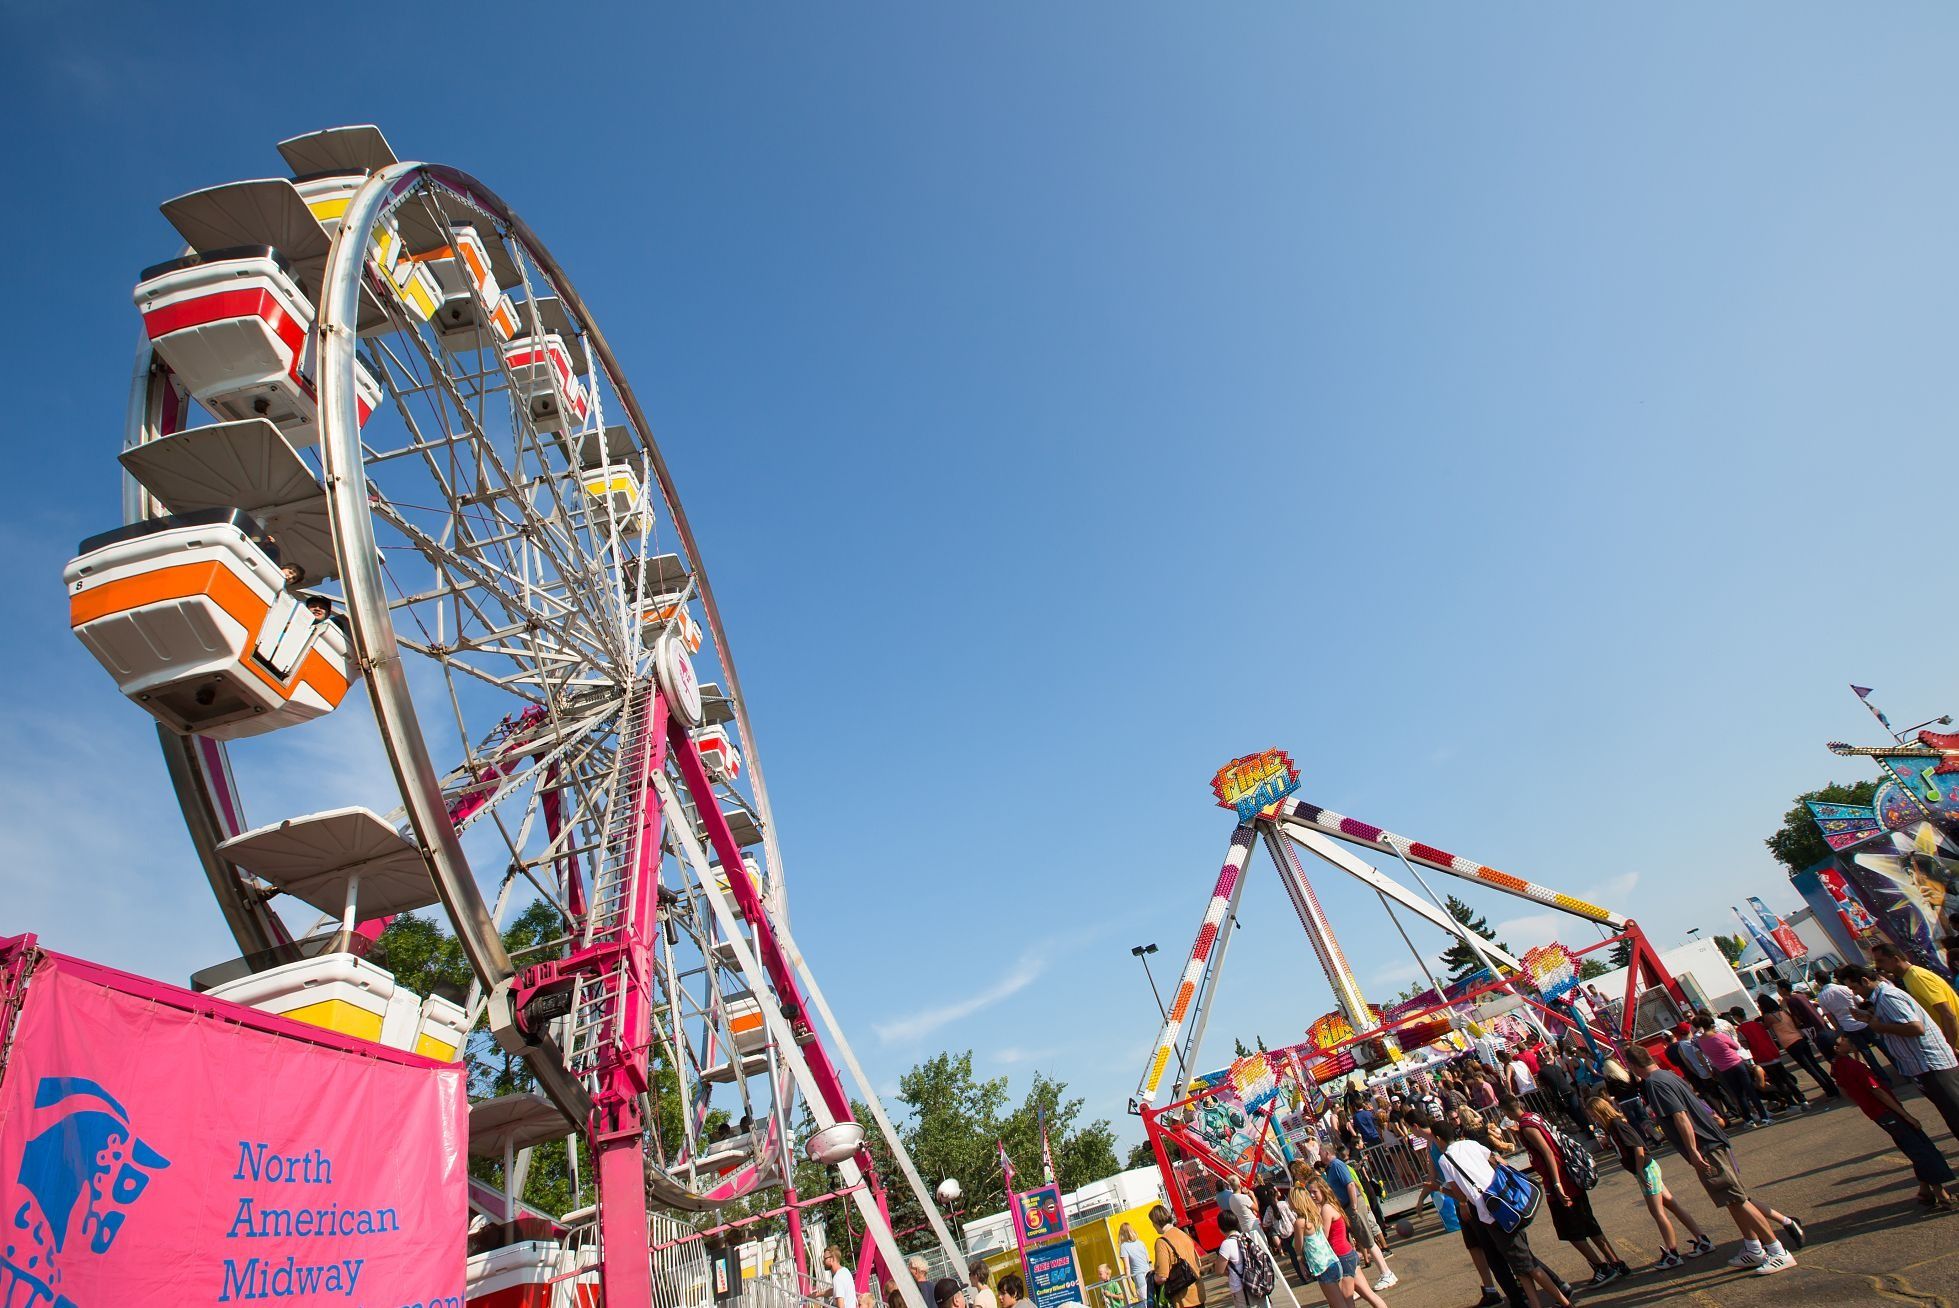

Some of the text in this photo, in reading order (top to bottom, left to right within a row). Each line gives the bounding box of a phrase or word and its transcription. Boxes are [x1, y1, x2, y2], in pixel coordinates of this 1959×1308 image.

[146, 301, 153, 310] 7
[75, 580, 84, 591] 8
[1217, 746, 1283, 803] FIRE
[1236, 768, 1302, 824] BALL
[1315, 1013, 1356, 1050] FIR
[233, 1140, 333, 1184] North
[226, 1197, 400, 1238] American
[1027, 1228, 1047, 1236] COUPONS
[1030, 1210, 1040, 1227] 5
[218, 1256, 364, 1302] Midway
